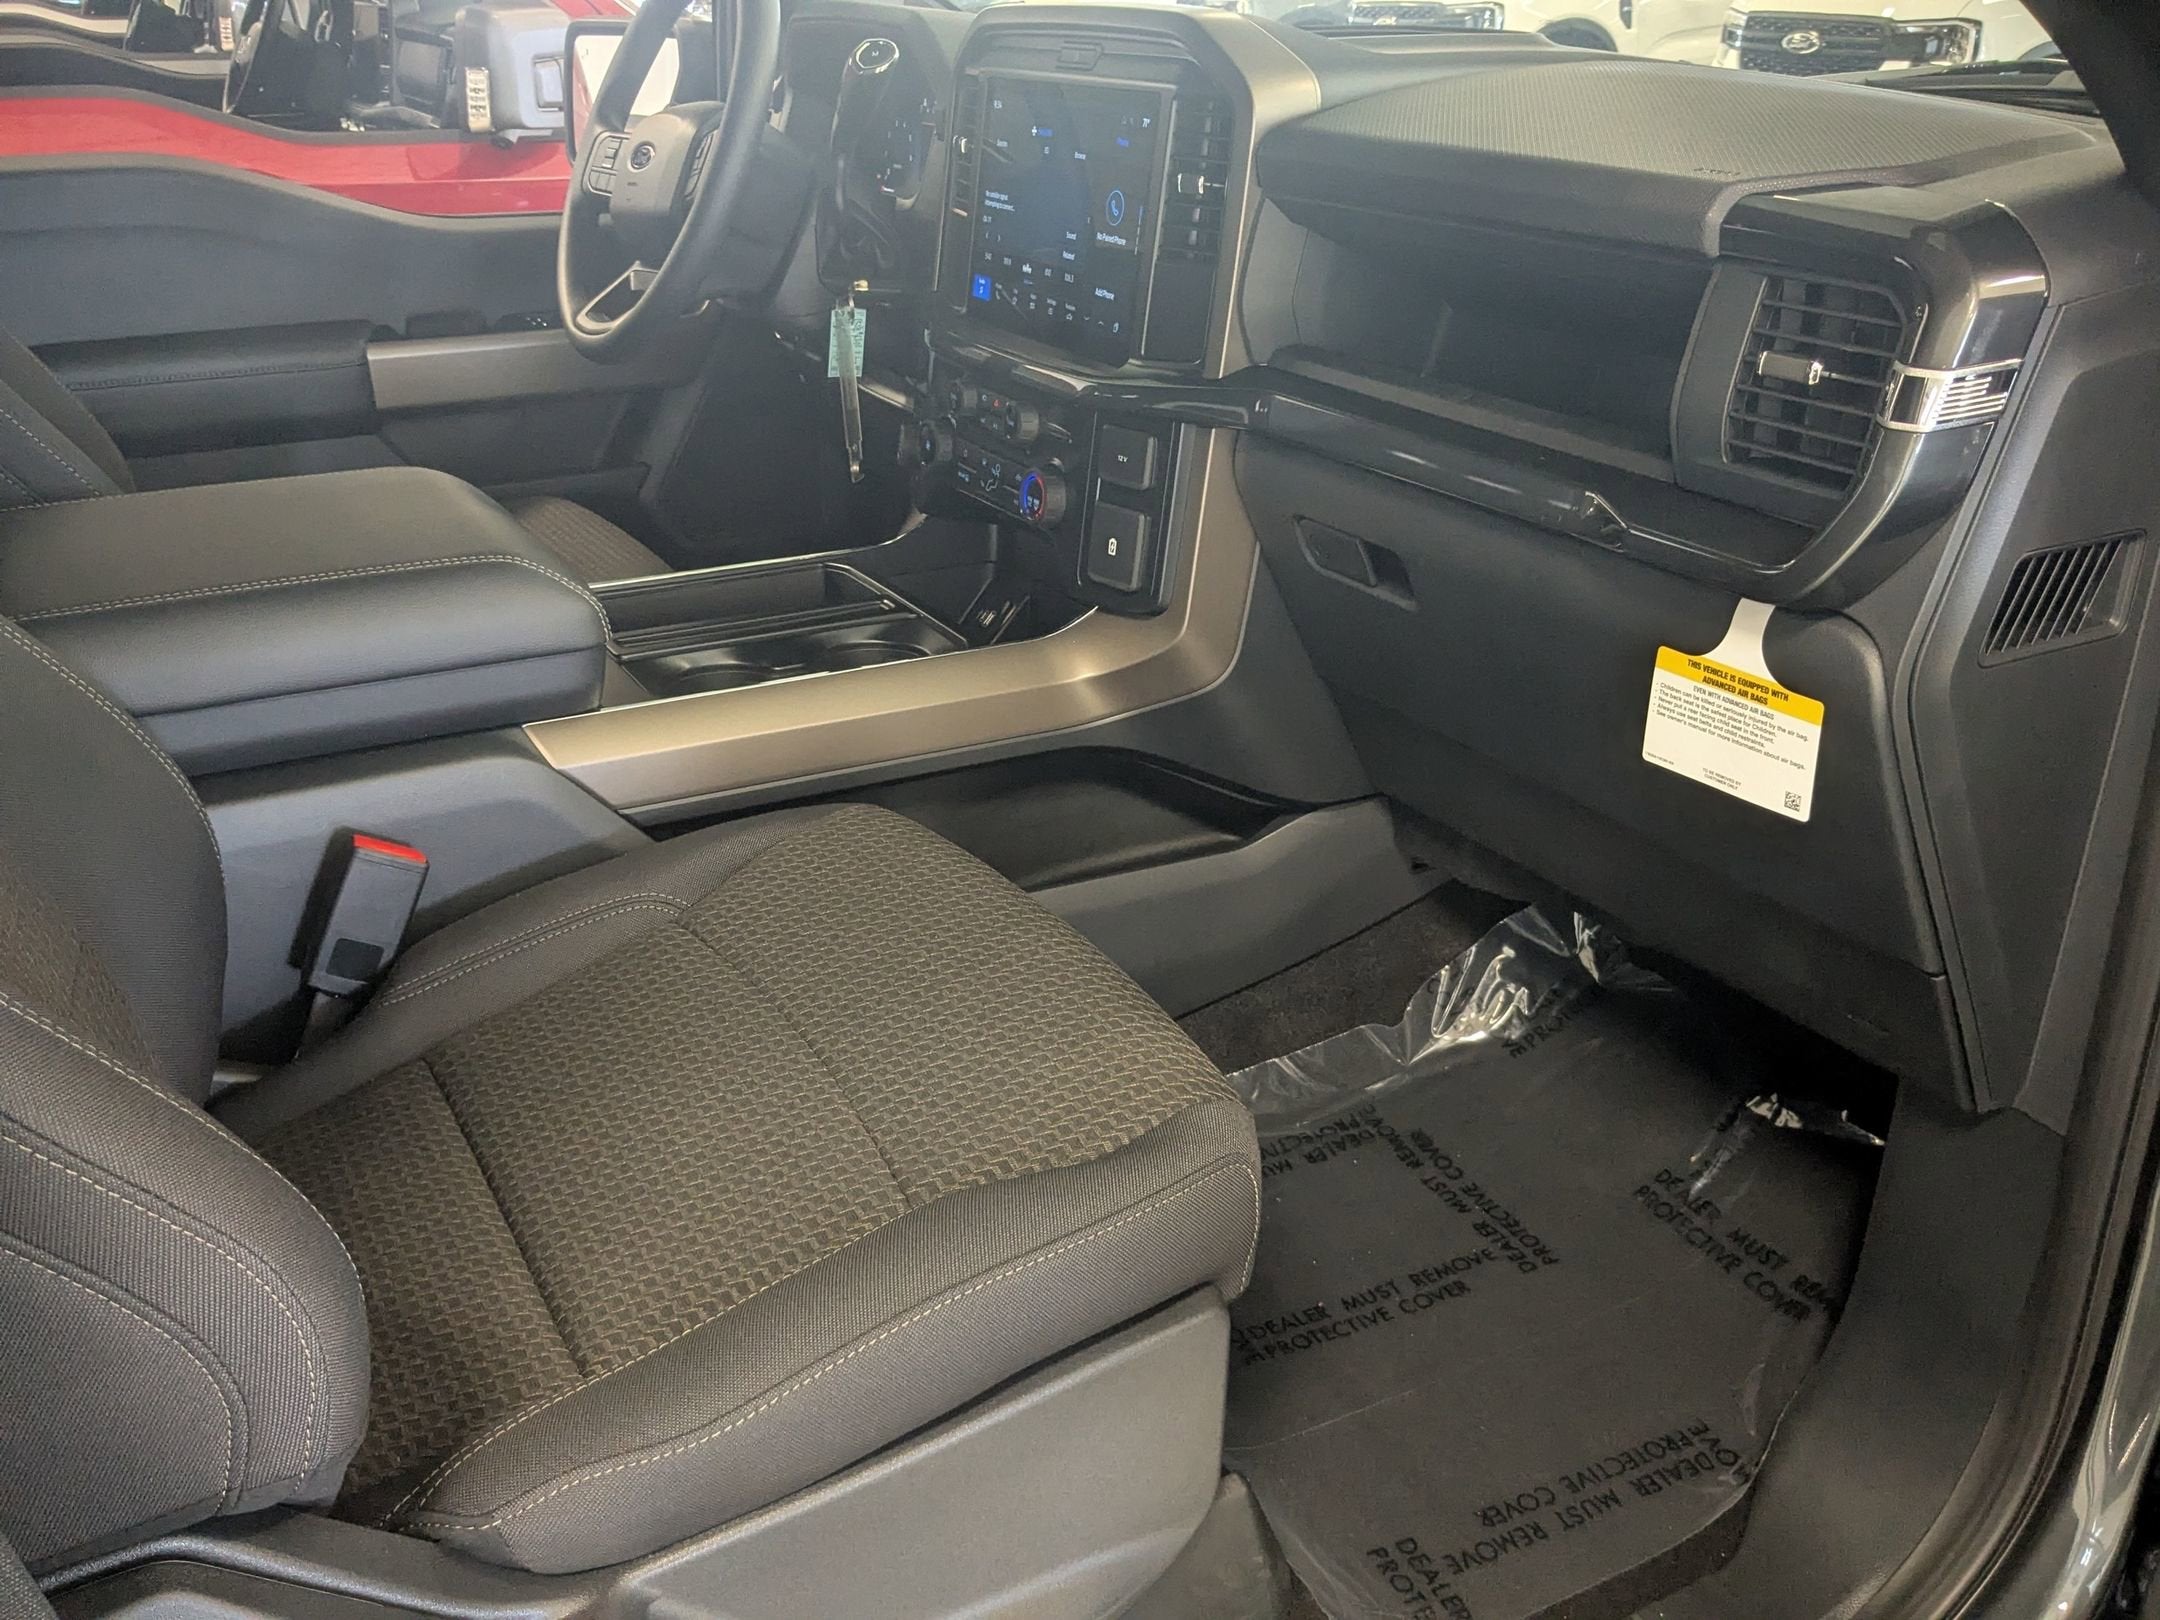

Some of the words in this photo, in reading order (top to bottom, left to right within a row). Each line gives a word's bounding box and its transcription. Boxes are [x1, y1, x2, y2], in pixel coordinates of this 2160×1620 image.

[1687, 659, 1701, 670] THIS
[1702, 664, 1728, 679] VEHICLE
[1729, 674, 1736, 682] IS
[1738, 677, 1769, 694] EQUIPPED
[1771, 688, 1788, 701] WITH
[1693, 685, 1706, 695] EVEN
[1707, 691, 1720, 700] WITH
[1722, 696, 1748, 710] ADVANCED
[1749, 706, 1758, 714] AIR
[1760, 709, 1774, 720] BAGS
[1702, 675, 1736, 693] ADVANCED
[1737, 688, 1748, 698] AIR
[1750, 692, 1768, 705] BAGS
[1657, 702, 1675, 714] Always
[1687, 714, 1697, 722] seat
[1698, 718, 1712, 727] belts
[1713, 723, 1723, 731] and
[1724, 727, 1737, 736] child
[1738, 733, 1765, 747] restraints.
[1658, 696, 1673, 705] Never
[1673, 702, 1682, 710] put
[1699, 711, 1715, 722] facing
[1716, 717, 1729, 726] child
[1730, 723, 1742, 731] seat
[1759, 733, 1774, 743] front.
[1660, 682, 1681, 694] Children
[1700, 697, 1715, 706] killed
[1723, 705, 1746, 719] seriously
[1748, 714, 1767, 727] injured
[1768, 722, 1775, 730] by
[1796, 732, 1808, 742] bag.
[1670, 693, 1681, 701] back
[1683, 698, 1694, 706] seat
[1710, 708, 1726, 718] safest
[1727, 714, 1741, 725] place
[1752, 723, 1776, 737] Children.
[1667, 714, 1686, 724] owner's
[1687, 721, 1707, 732] manual
[1716, 733, 1730, 741] more
[1731, 737, 1762, 753] information
[1763, 750, 1779, 760] about
[1789, 760, 1804, 770] bags.
[1410, 1127, 1464, 1181] COVER
[1420, 1175, 1471, 1214] MUST
[1458, 1181, 1560, 1266] PROTECTIVE
[1472, 1220, 1538, 1274] DEALER
[1632, 1184, 1744, 1274] PROTECTIVE
[1726, 1227, 1790, 1271] MUST
[1248, 1304, 1332, 1342] DEALER
[1340, 1278, 1402, 1312] MUST
[1407, 1247, 1499, 1287] REMOVE
[1263, 1306, 1397, 1359] PROTECTIVE
[1398, 1279, 1472, 1315] COVER
[1558, 1428, 1694, 1495] PROTECTIVE
[1632, 1450, 1716, 1498] DEALER
[1473, 1486, 1557, 1529] COVER
[1556, 1487, 1623, 1533] MUST
[1443, 1520, 1550, 1577] REMOVE
